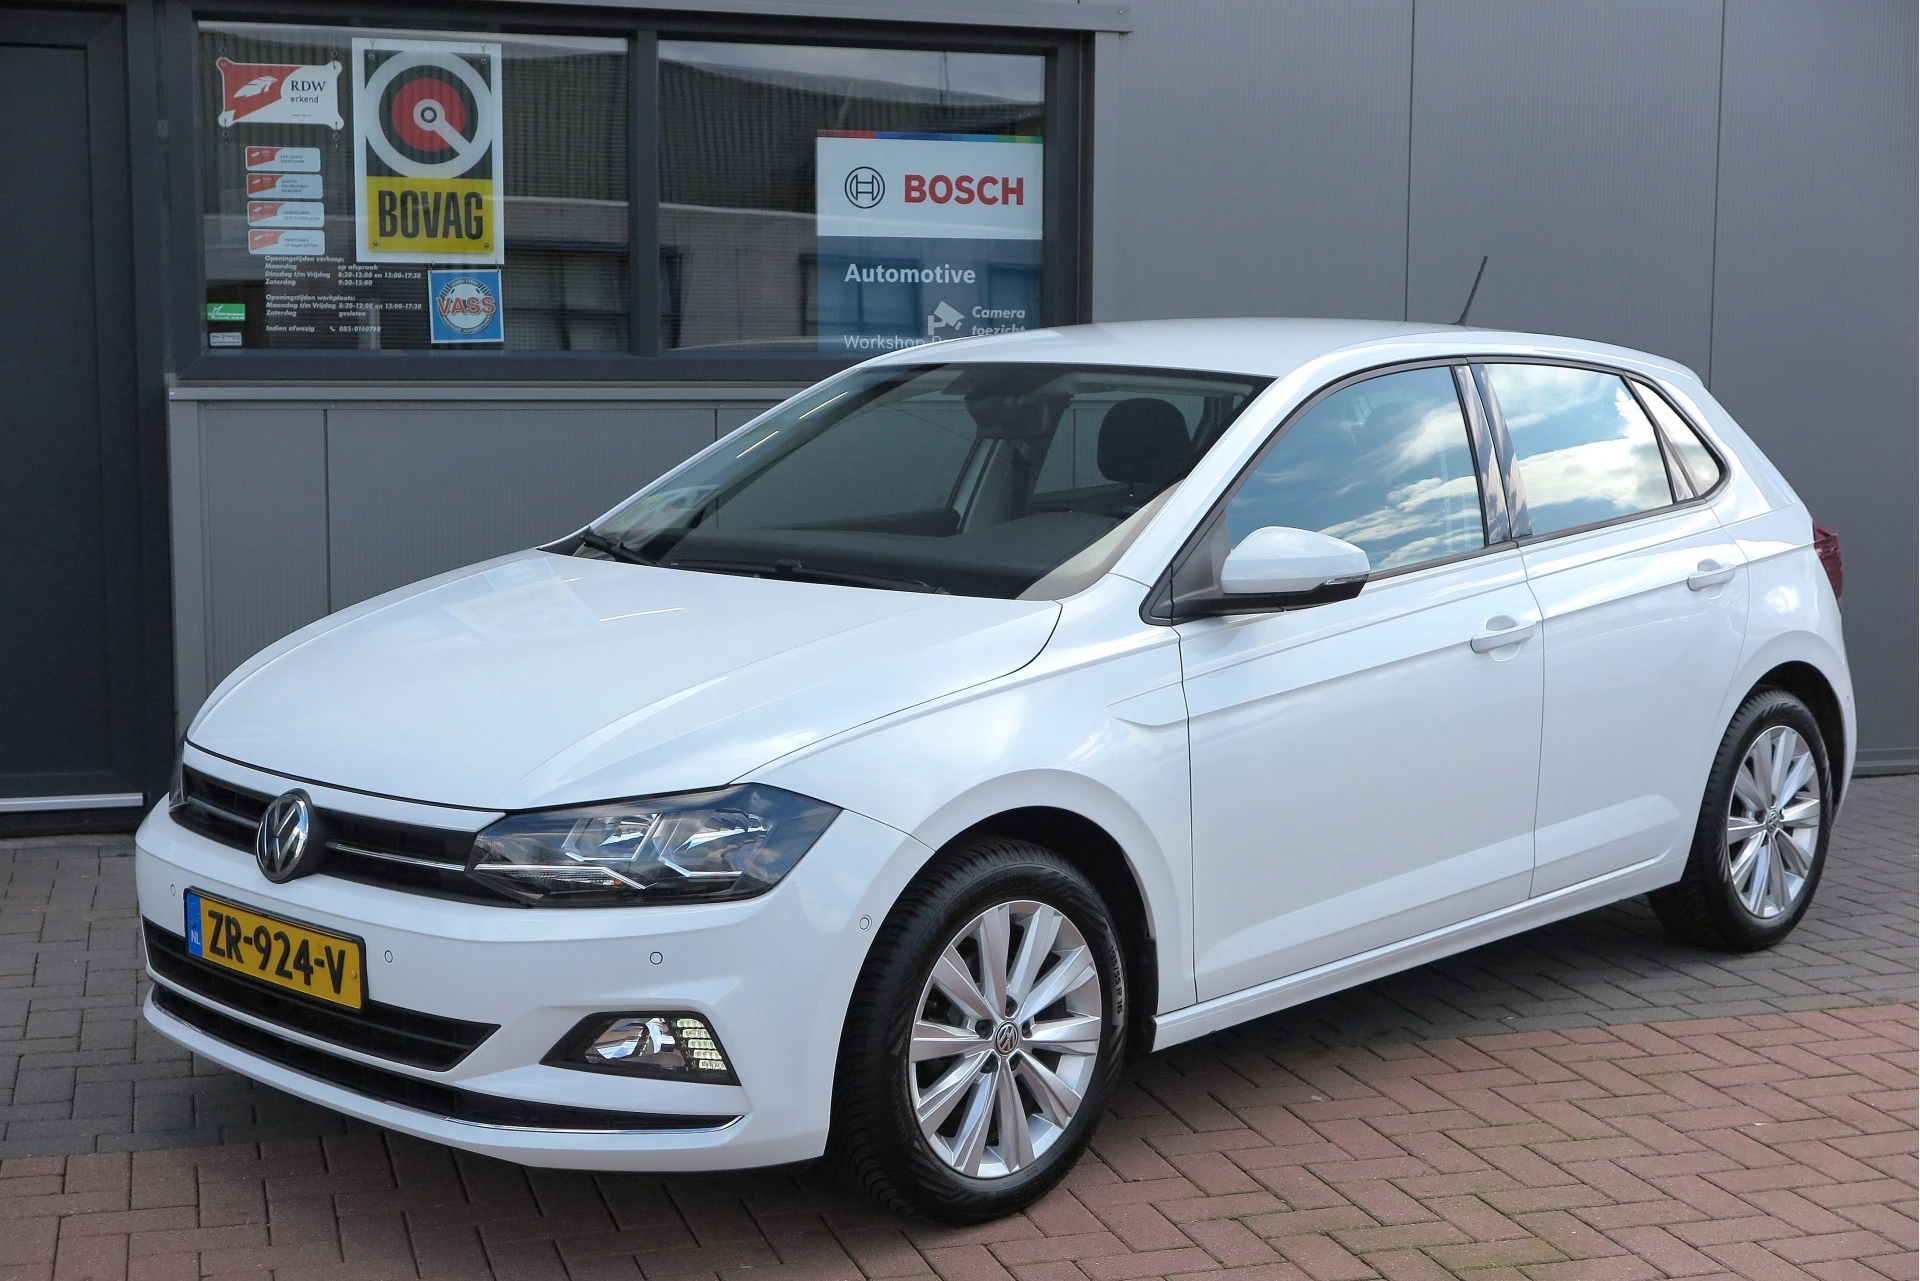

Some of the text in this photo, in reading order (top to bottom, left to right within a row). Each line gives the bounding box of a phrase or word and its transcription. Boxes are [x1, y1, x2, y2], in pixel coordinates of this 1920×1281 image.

[290, 80, 326, 92] RDW
[290, 95, 319, 103] erkend
[904, 174, 1024, 206] BOSCH
[378, 190, 483, 240] BOVAG
[264, 255, 315, 263] Openingstijden
[307, 271, 331, 279] Vrijdag
[844, 263, 976, 284] Automotive
[317, 294, 355, 302] werkplaats:
[436, 296, 496, 315] VASS
[972, 305, 1026, 318] Camera
[338, 310, 366, 318] gesloten
[288, 325, 315, 333] afwezig
[971, 324, 1026, 336] toezicht
[190, 929, 202, 946] NL
[208, 909, 346, 995] ZR-924-V
